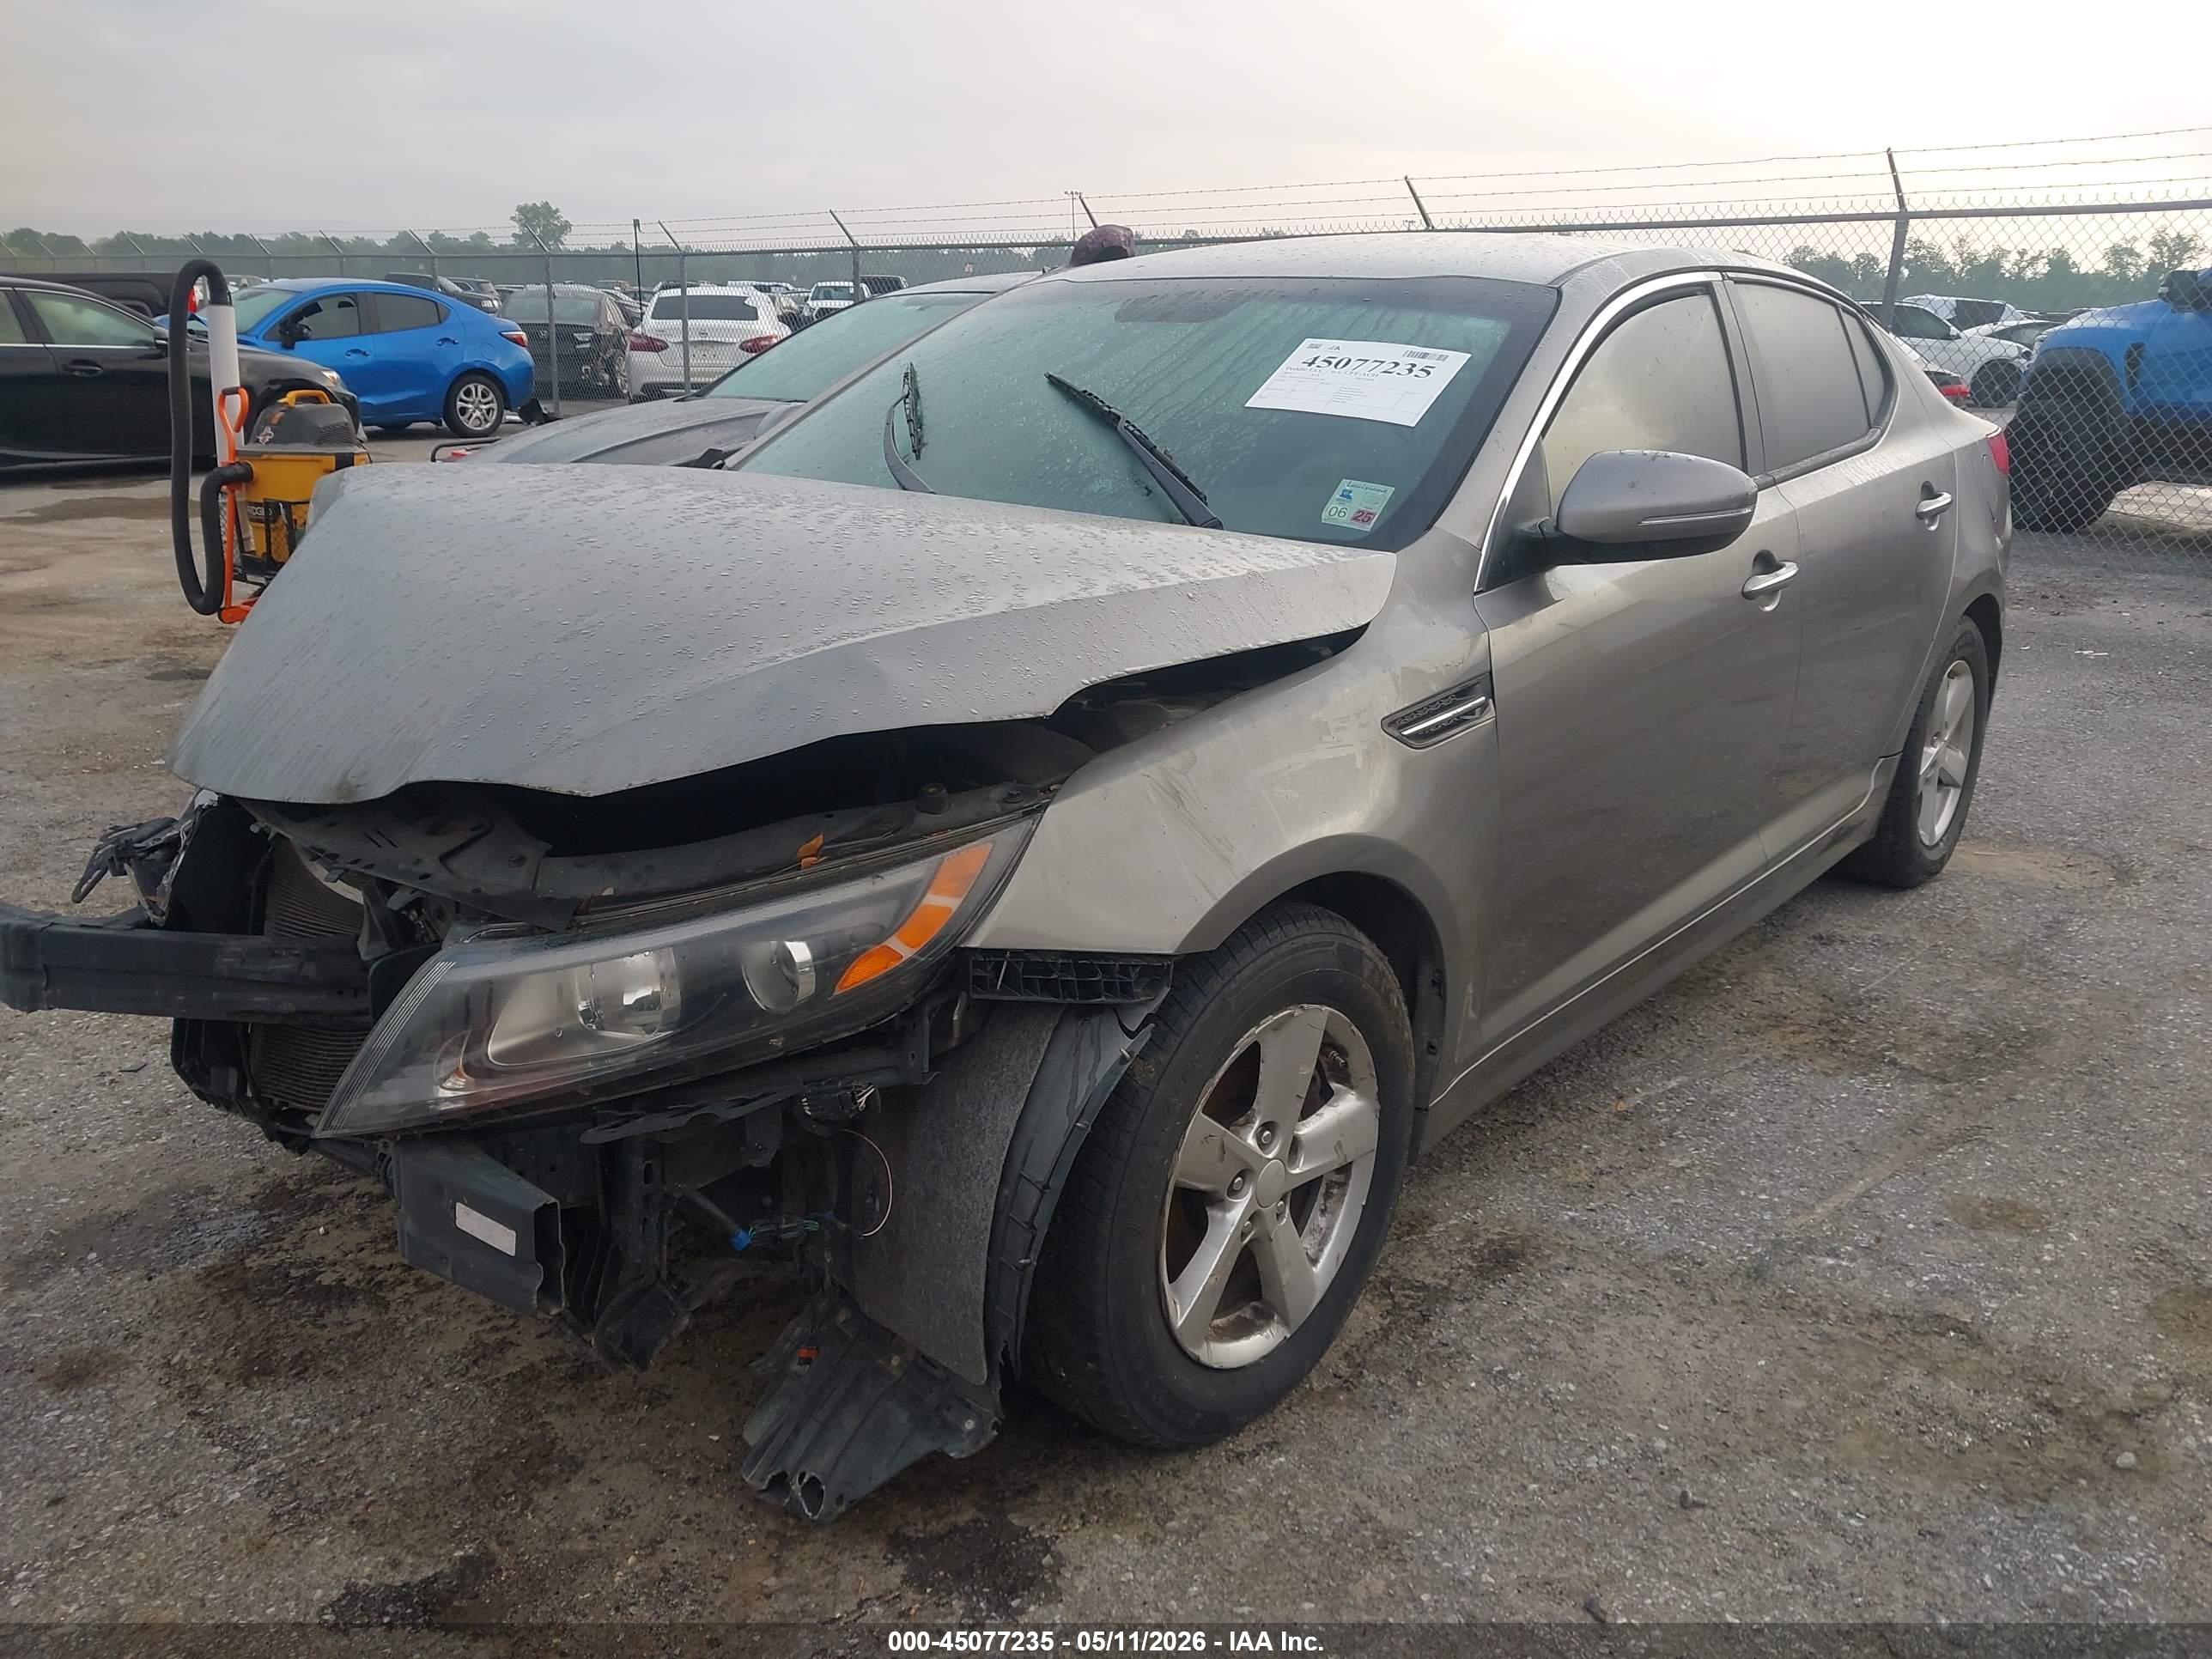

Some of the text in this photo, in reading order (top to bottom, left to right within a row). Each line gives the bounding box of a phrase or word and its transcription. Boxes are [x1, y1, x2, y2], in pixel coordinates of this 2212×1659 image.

[1302, 355, 1437, 380] 45077235
[1328, 506, 1374, 523] 06 25
